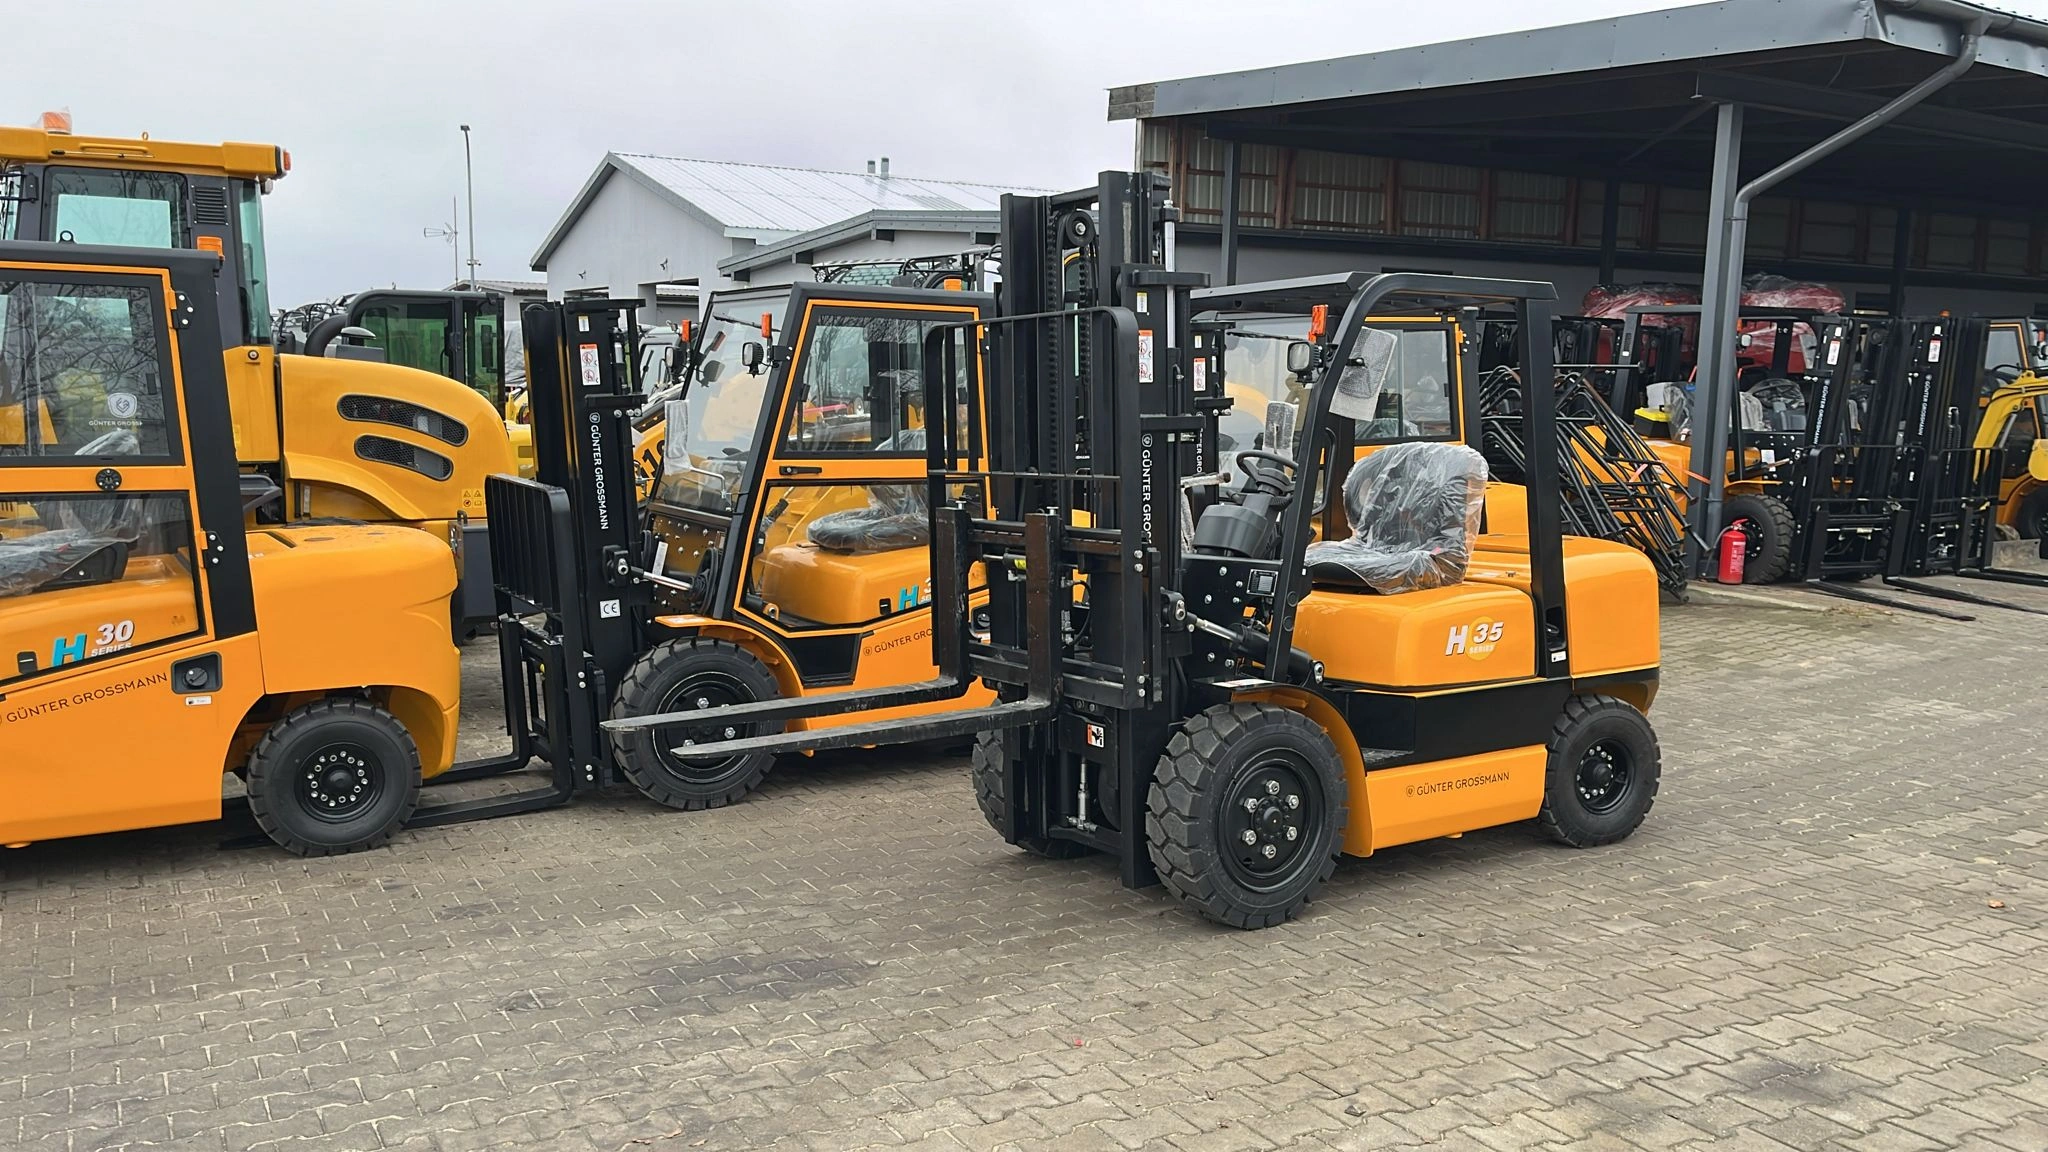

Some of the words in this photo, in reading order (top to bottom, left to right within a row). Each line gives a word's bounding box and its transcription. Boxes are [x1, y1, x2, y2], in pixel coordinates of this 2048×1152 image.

[590, 424, 602, 466] GÜNTER
[1142, 449, 1153, 502] GÜNTER
[594, 467, 609, 530] GROSSMANN
[603, 602, 618, 615] CE
[898, 584, 919, 611] H
[52, 633, 87, 668] H
[95, 620, 135, 645] 30
[874, 634, 912, 653] GÜNTER
[913, 628, 933, 641] GRO
[1445, 625, 1469, 656] H
[1473, 622, 1504, 644] 35
[6, 698, 69, 723] GÜNTER
[72, 672, 168, 704] GROSSMANN
[1416, 782, 1454, 796] GÜNTER
[1455, 772, 1510, 790] GROSSMANN
